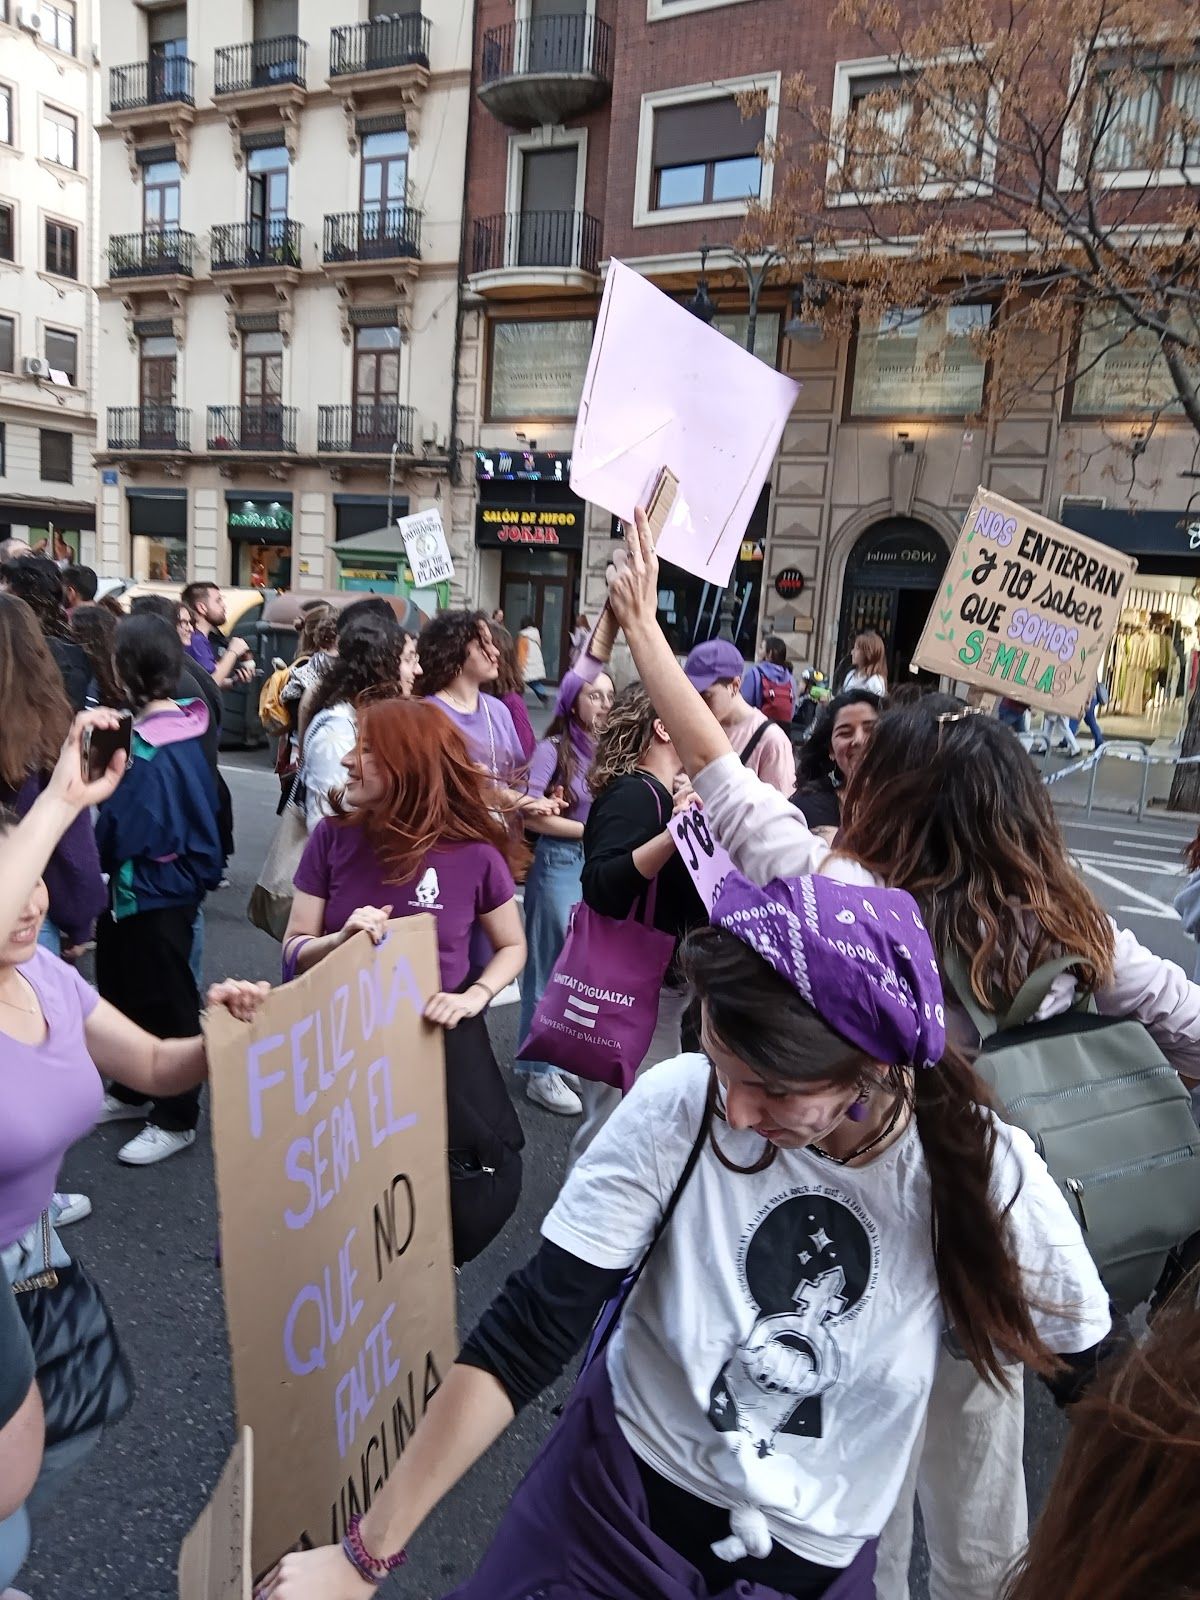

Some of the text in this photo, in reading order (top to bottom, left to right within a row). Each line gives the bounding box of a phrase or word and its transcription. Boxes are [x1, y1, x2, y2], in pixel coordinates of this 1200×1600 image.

[482, 508, 576, 526] SALÓN DE JUEGO
[497, 525, 560, 545] JOKER
[974, 506, 1018, 548] NOS
[417, 562, 450, 583] PLANET
[960, 592, 1079, 663] QUE SOMOS
[1031, 580, 1103, 631] saben
[553, 972, 579, 989] UNITAT
[246, 984, 355, 1139] FELIZ
[367, 1056, 418, 1149] EL
[283, 1173, 416, 1376] QUE NO
[335, 1302, 401, 1458] FALTE
